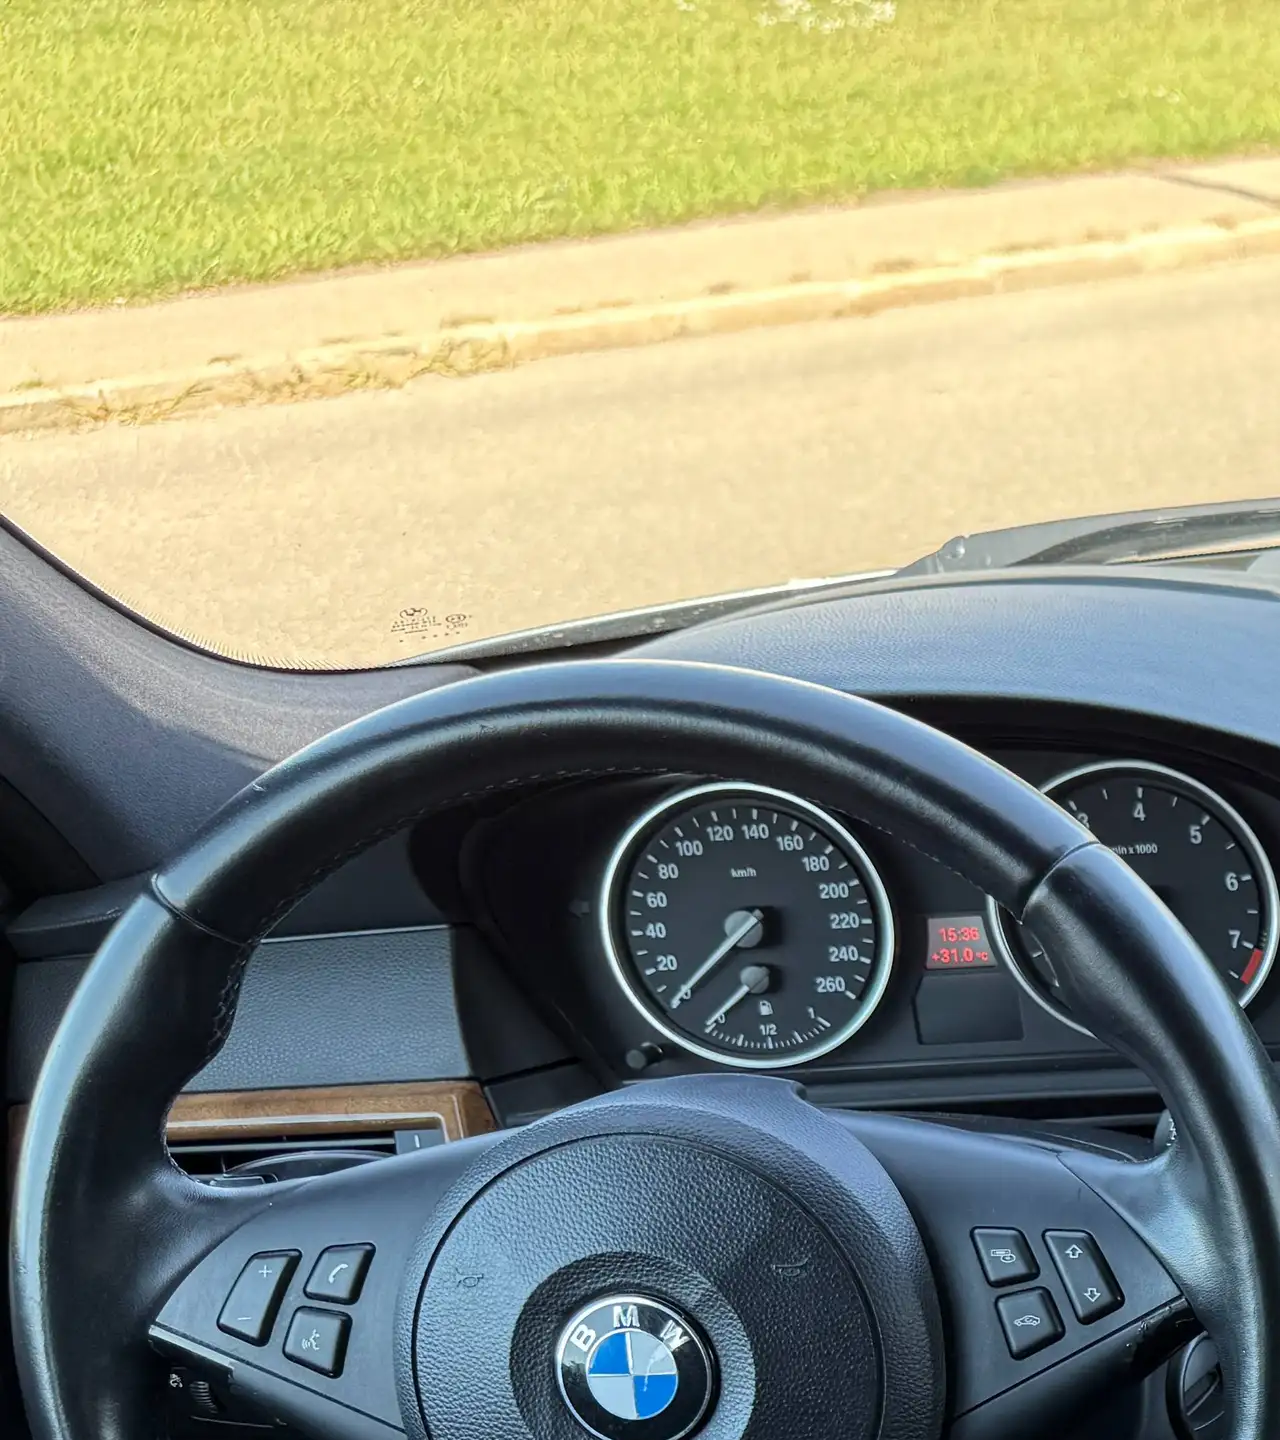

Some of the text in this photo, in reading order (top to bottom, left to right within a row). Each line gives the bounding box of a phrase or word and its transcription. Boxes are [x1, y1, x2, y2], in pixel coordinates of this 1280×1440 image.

[1133, 803, 1146, 821] 4
[707, 825, 733, 842] 120
[742, 824, 769, 840] 140
[1190, 827, 1202, 844] 5
[676, 841, 703, 857] 100
[777, 836, 803, 851] 160
[1135, 843, 1158, 855] 1000
[659, 864, 679, 880] 80
[802, 856, 829, 872] 180
[731, 867, 757, 878] km/h
[1225, 873, 1239, 891] 6
[820, 883, 849, 899] 200
[647, 892, 667, 908] 60
[830, 914, 860, 929] 220
[646, 923, 666, 939] 40
[938, 927, 980, 942] 15:36
[1229, 931, 1241, 948] 7
[829, 947, 858, 962] 240
[931, 948, 974, 963] +31.0
[657, 956, 677, 971] 20
[816, 977, 845, 993] 260
[808, 1006, 816, 1019] 1
[760, 1023, 777, 1036] 1/2
[570, 1305, 690, 1352] BMW
